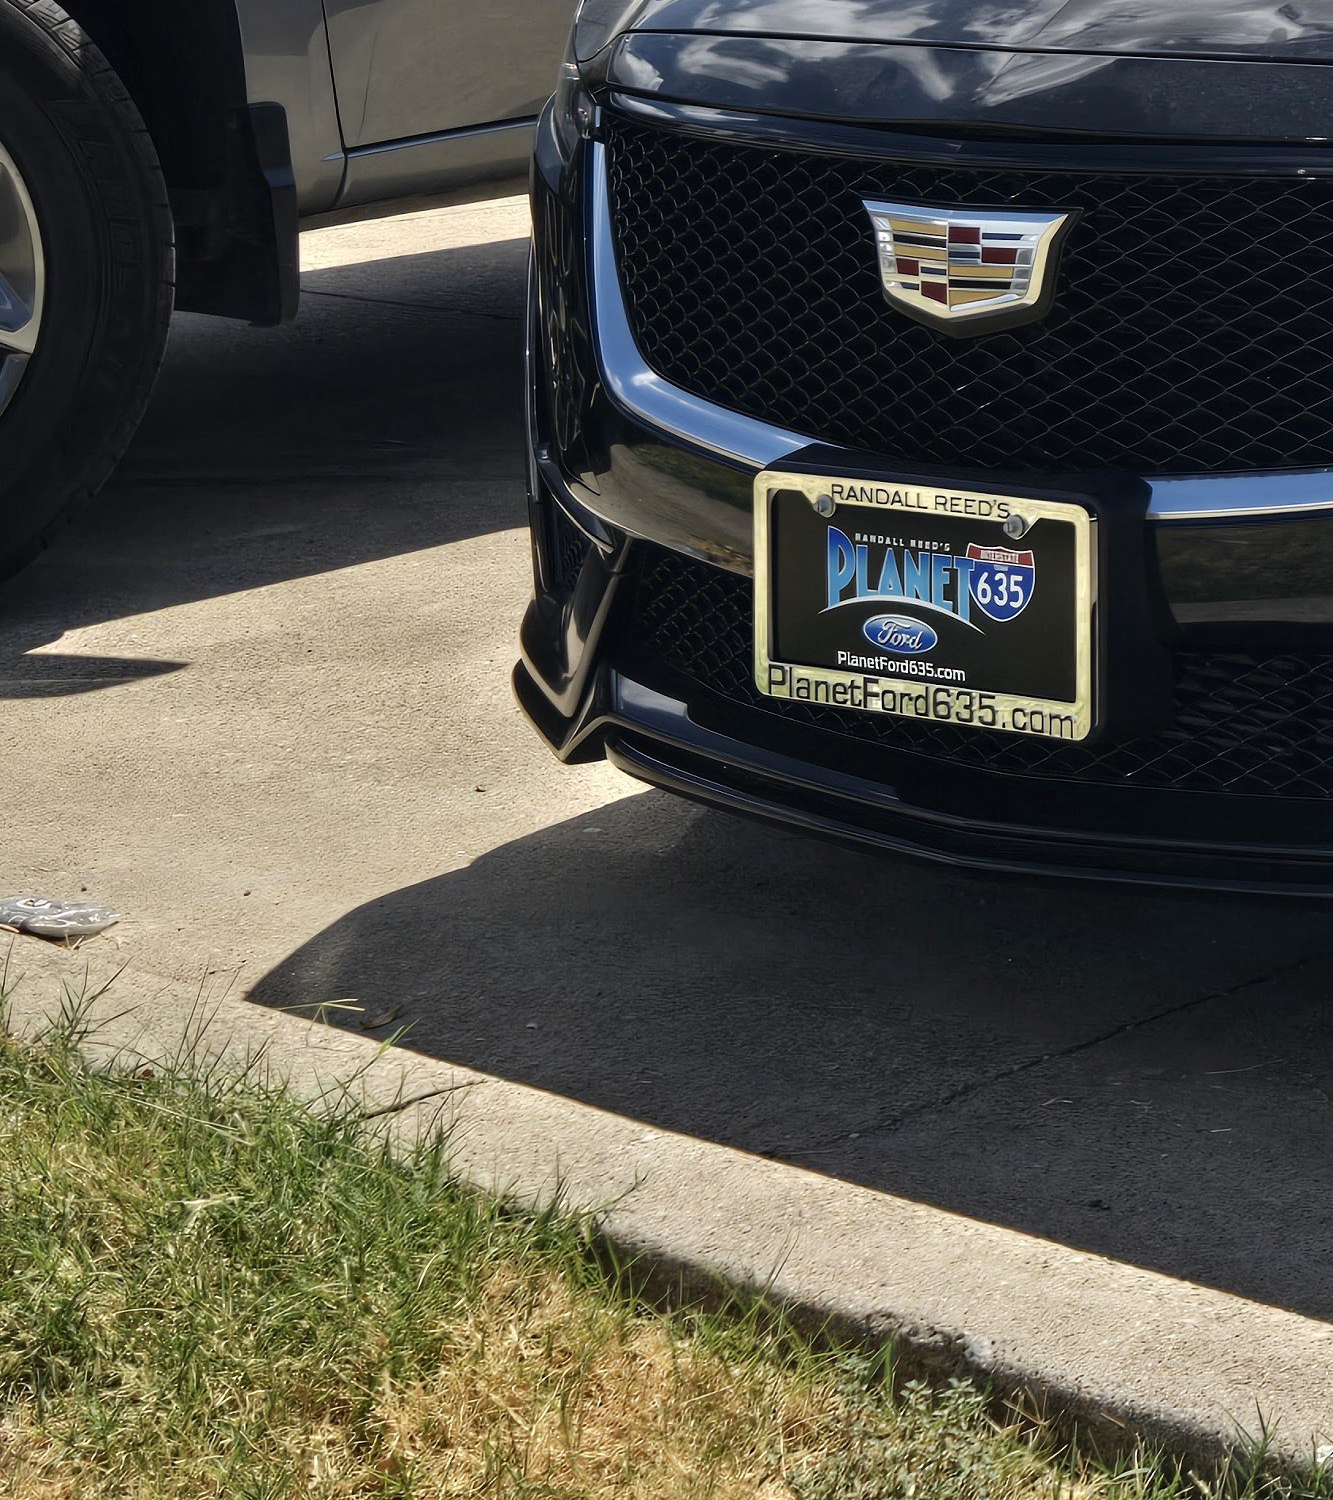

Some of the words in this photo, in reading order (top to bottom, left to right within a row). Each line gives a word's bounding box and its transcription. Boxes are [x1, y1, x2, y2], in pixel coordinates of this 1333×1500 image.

[831, 483, 929, 510] RANDALL
[934, 494, 1011, 519] REED'S
[827, 525, 976, 623] PLANET
[976, 571, 1024, 609] 635
[876, 619, 924, 650] Ford
[837, 650, 966, 682] PlanetFord635.com
[768, 664, 1076, 740] PlanetFord635.com
